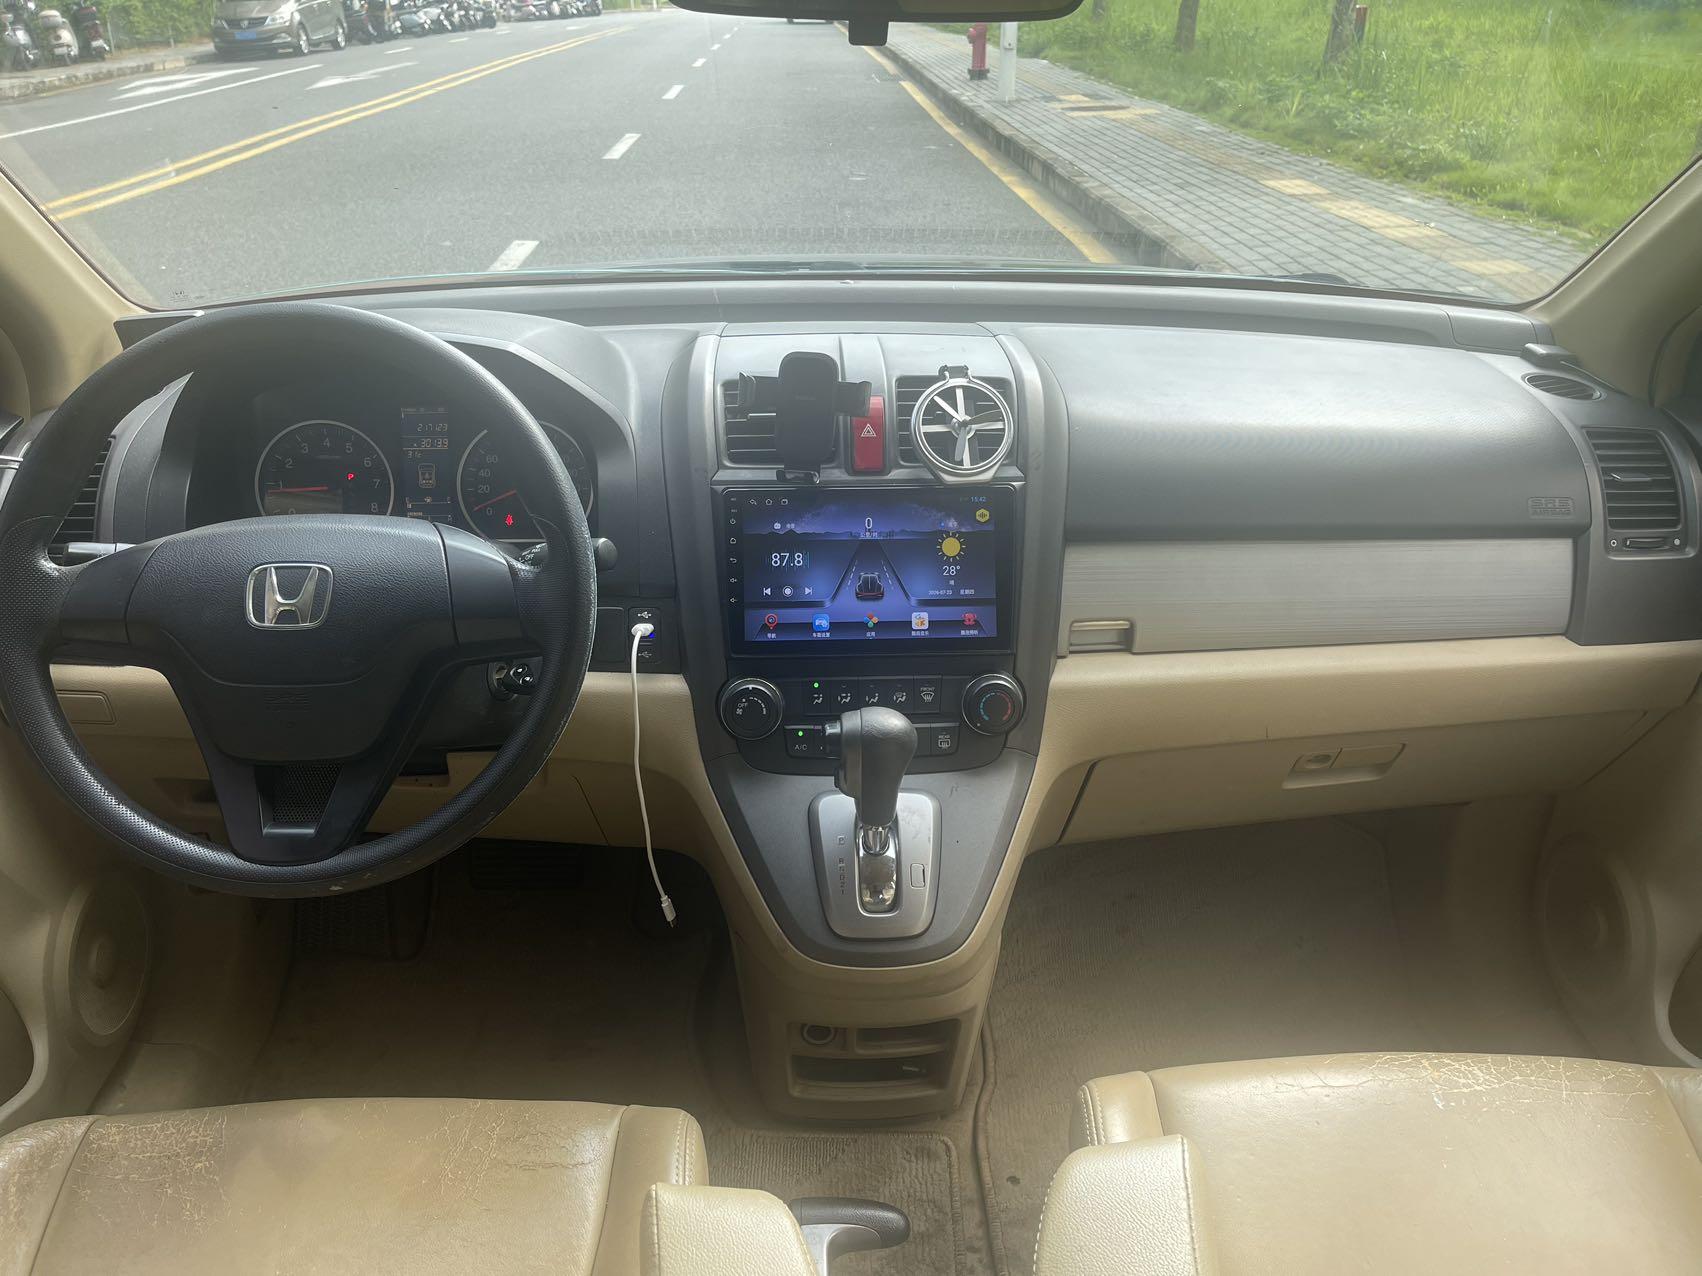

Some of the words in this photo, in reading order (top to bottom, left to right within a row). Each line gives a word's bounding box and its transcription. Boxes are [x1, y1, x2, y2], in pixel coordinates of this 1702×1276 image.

[301, 443, 309, 453] 3
[345, 443, 353, 453] 5
[284, 458, 293, 468] 2
[364, 457, 372, 467] 6
[486, 455, 498, 463] 60
[373, 479, 380, 488] 7
[478, 485, 490, 493] 20
[371, 502, 379, 512] 8
[864, 517, 873, 529] 0
[771, 552, 804, 567] 87.8
[942, 565, 961, 576] 28°
